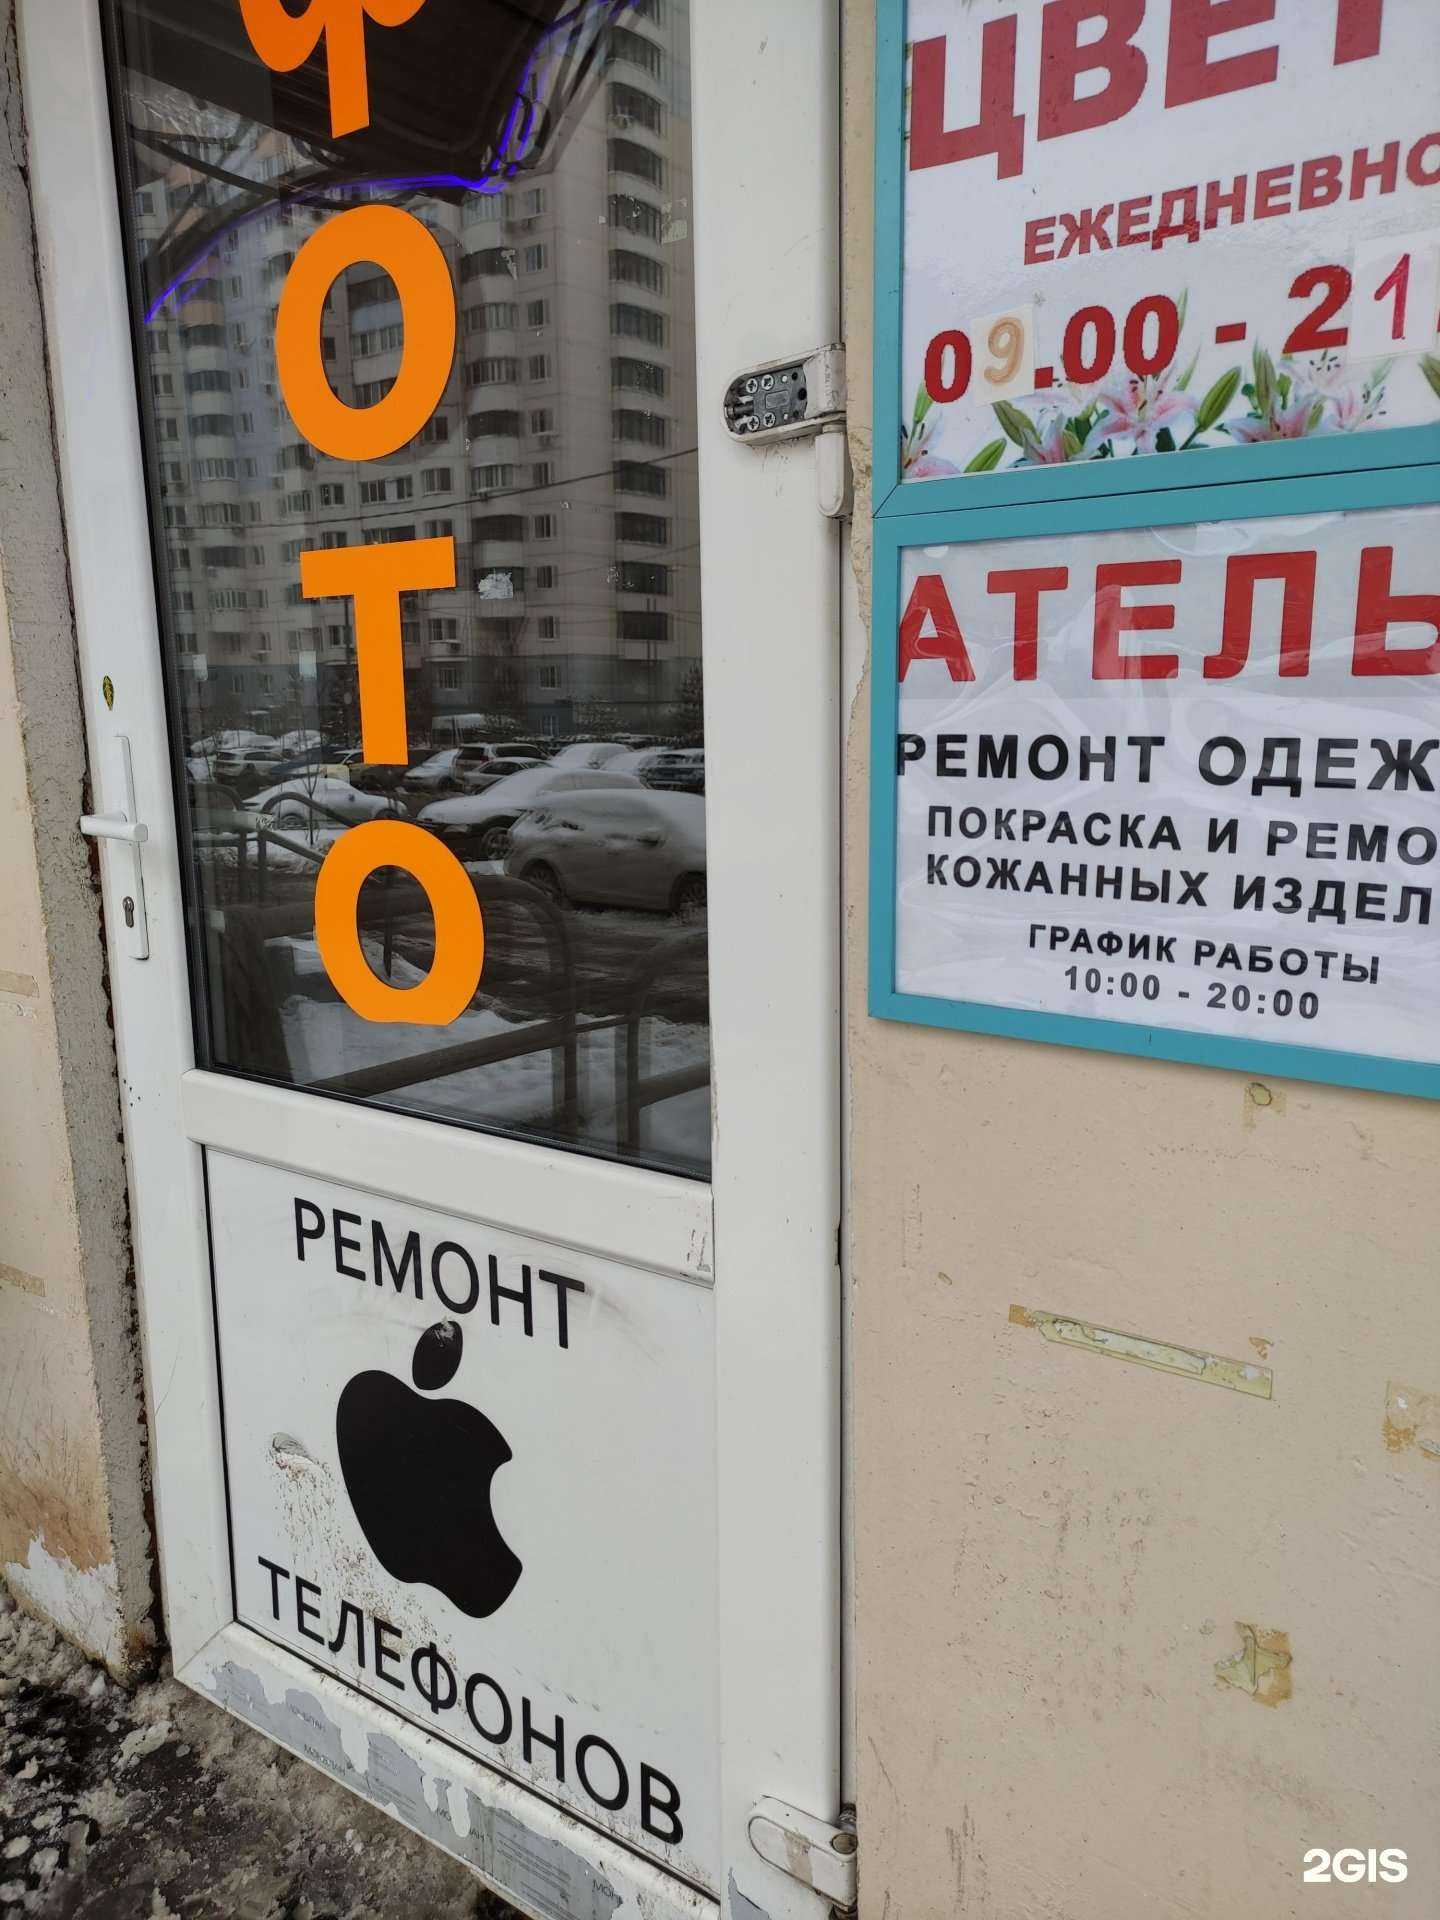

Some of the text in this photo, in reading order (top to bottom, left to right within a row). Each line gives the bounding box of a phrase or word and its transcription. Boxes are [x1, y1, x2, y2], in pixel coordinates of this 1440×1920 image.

[1024, 132, 1440, 266] ЕЖЕДНЕВНО
[924, 294, 1181, 404] 09.00
[897, 546, 1440, 683] АТЕЛЬ
[896, 733, 1440, 798] РЕМОНТ ОДЕЖ
[928, 805, 1439, 867] ПОКРАСКА И РЕМО
[927, 853, 1432, 926] КОЖАННЫХ ИЗДЕЛ
[1029, 923, 1381, 985] ГРАФИК РАБОТЫ
[1064, 965, 1161, 1001] 10:00
[1207, 982, 1320, 1020] 20:00
[293, 1197, 585, 1349] РЕМОНТ
[258, 1555, 684, 1845] ТЕЛЕФОНОВ
